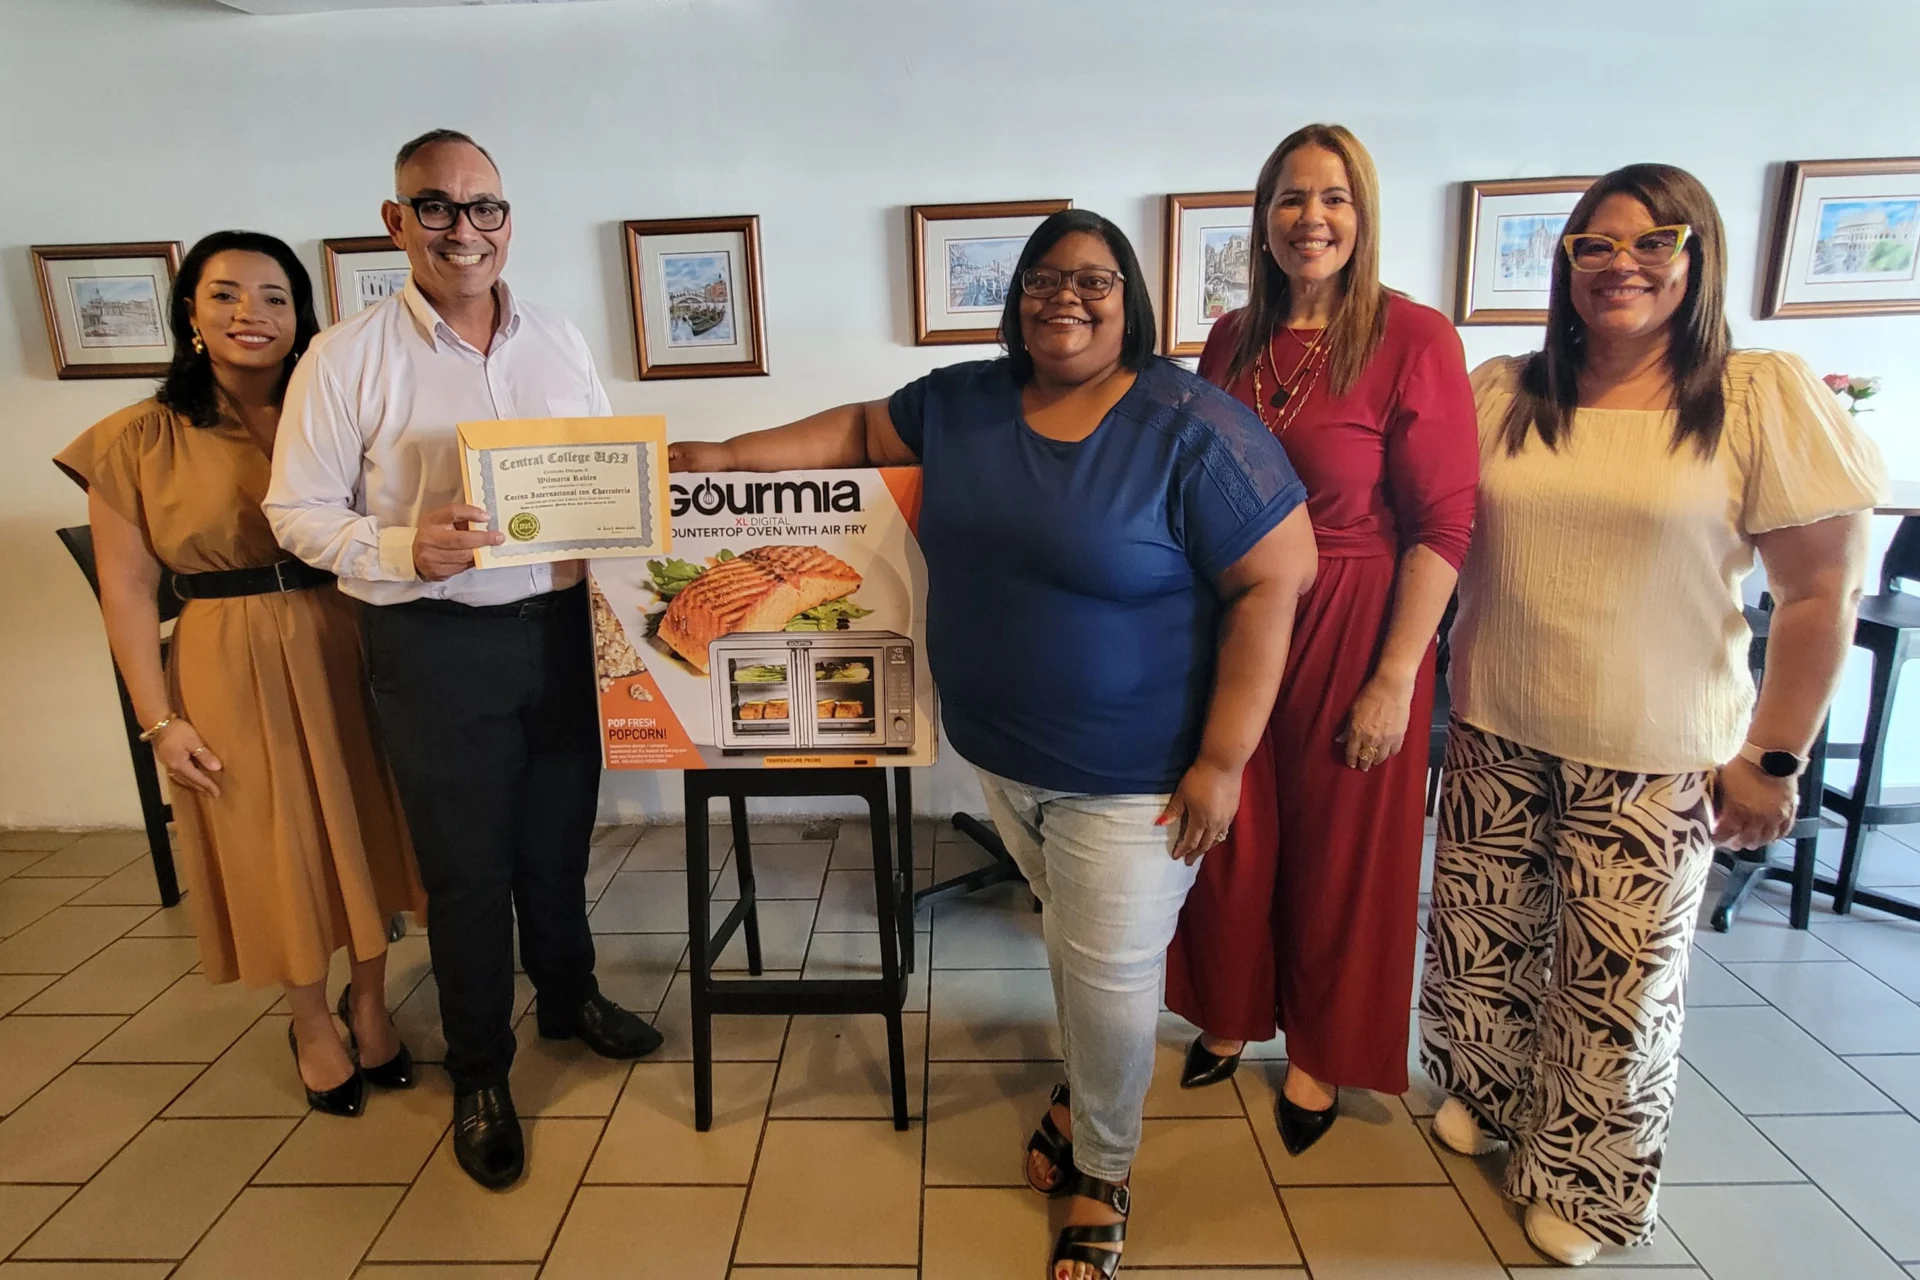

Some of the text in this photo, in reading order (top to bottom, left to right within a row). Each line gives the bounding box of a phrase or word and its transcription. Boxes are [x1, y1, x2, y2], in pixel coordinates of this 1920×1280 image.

[499, 454, 543, 471] Central
[547, 452, 590, 464] College
[537, 474, 597, 484] Wilmaris Robles
[504, 493, 529, 501] Cocina
[530, 489, 578, 499] Internacional
[591, 486, 631, 495] Charcutería
[669, 477, 862, 517] Gourmia
[735, 517, 790, 526] XL DIGITAL
[671, 524, 867, 539] OUNTERTOP OVEN WITH AIR FRY
[607, 718, 656, 728] POP FRESH
[609, 728, 667, 740] POPCORN!
